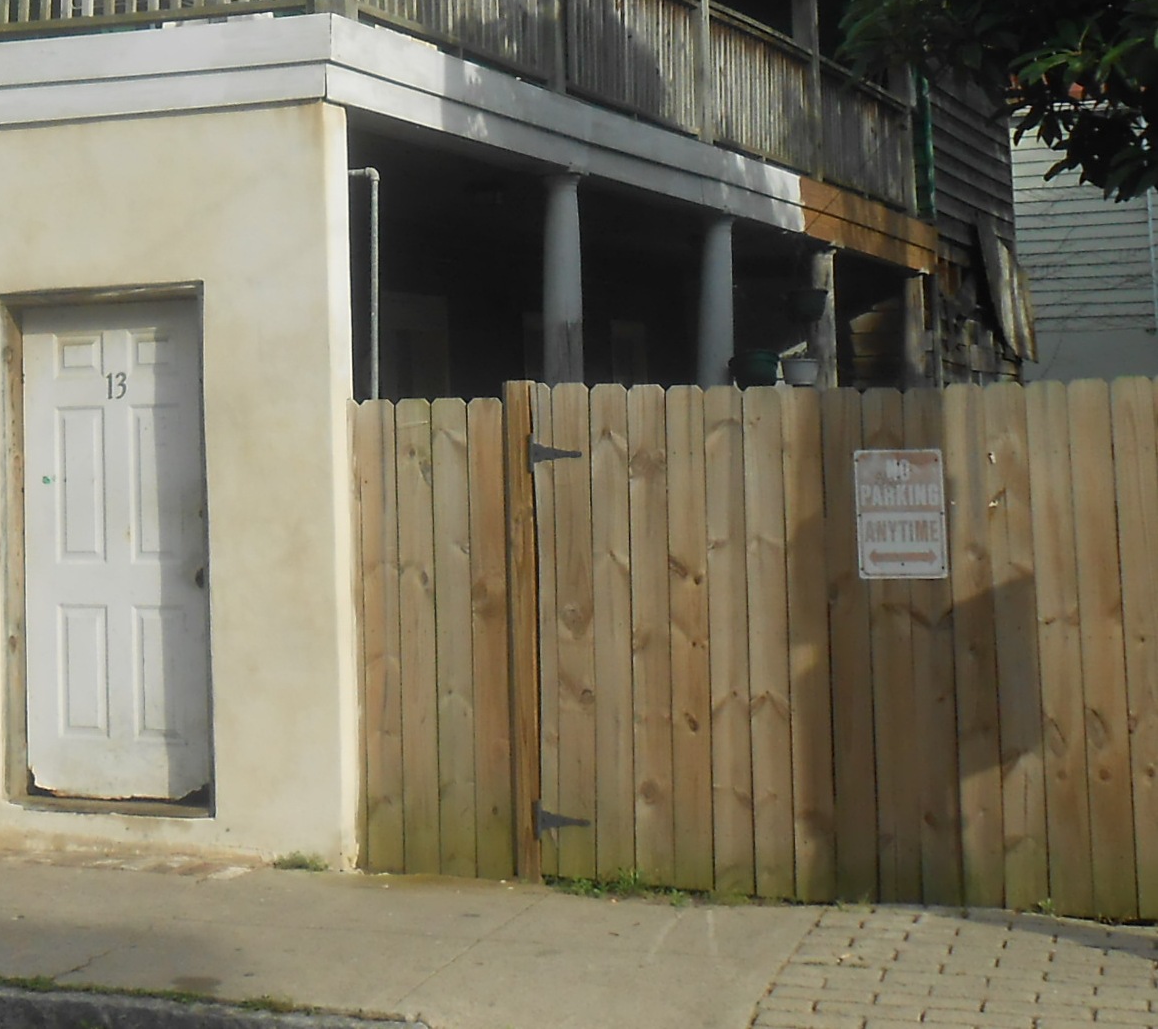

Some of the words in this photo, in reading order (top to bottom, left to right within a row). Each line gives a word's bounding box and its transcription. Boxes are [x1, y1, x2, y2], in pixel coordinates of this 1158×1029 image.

[106, 372, 127, 400] 13
[885, 459, 910, 481] NO
[860, 483, 940, 506] PARKING
[865, 520, 940, 543] ANYTIME
